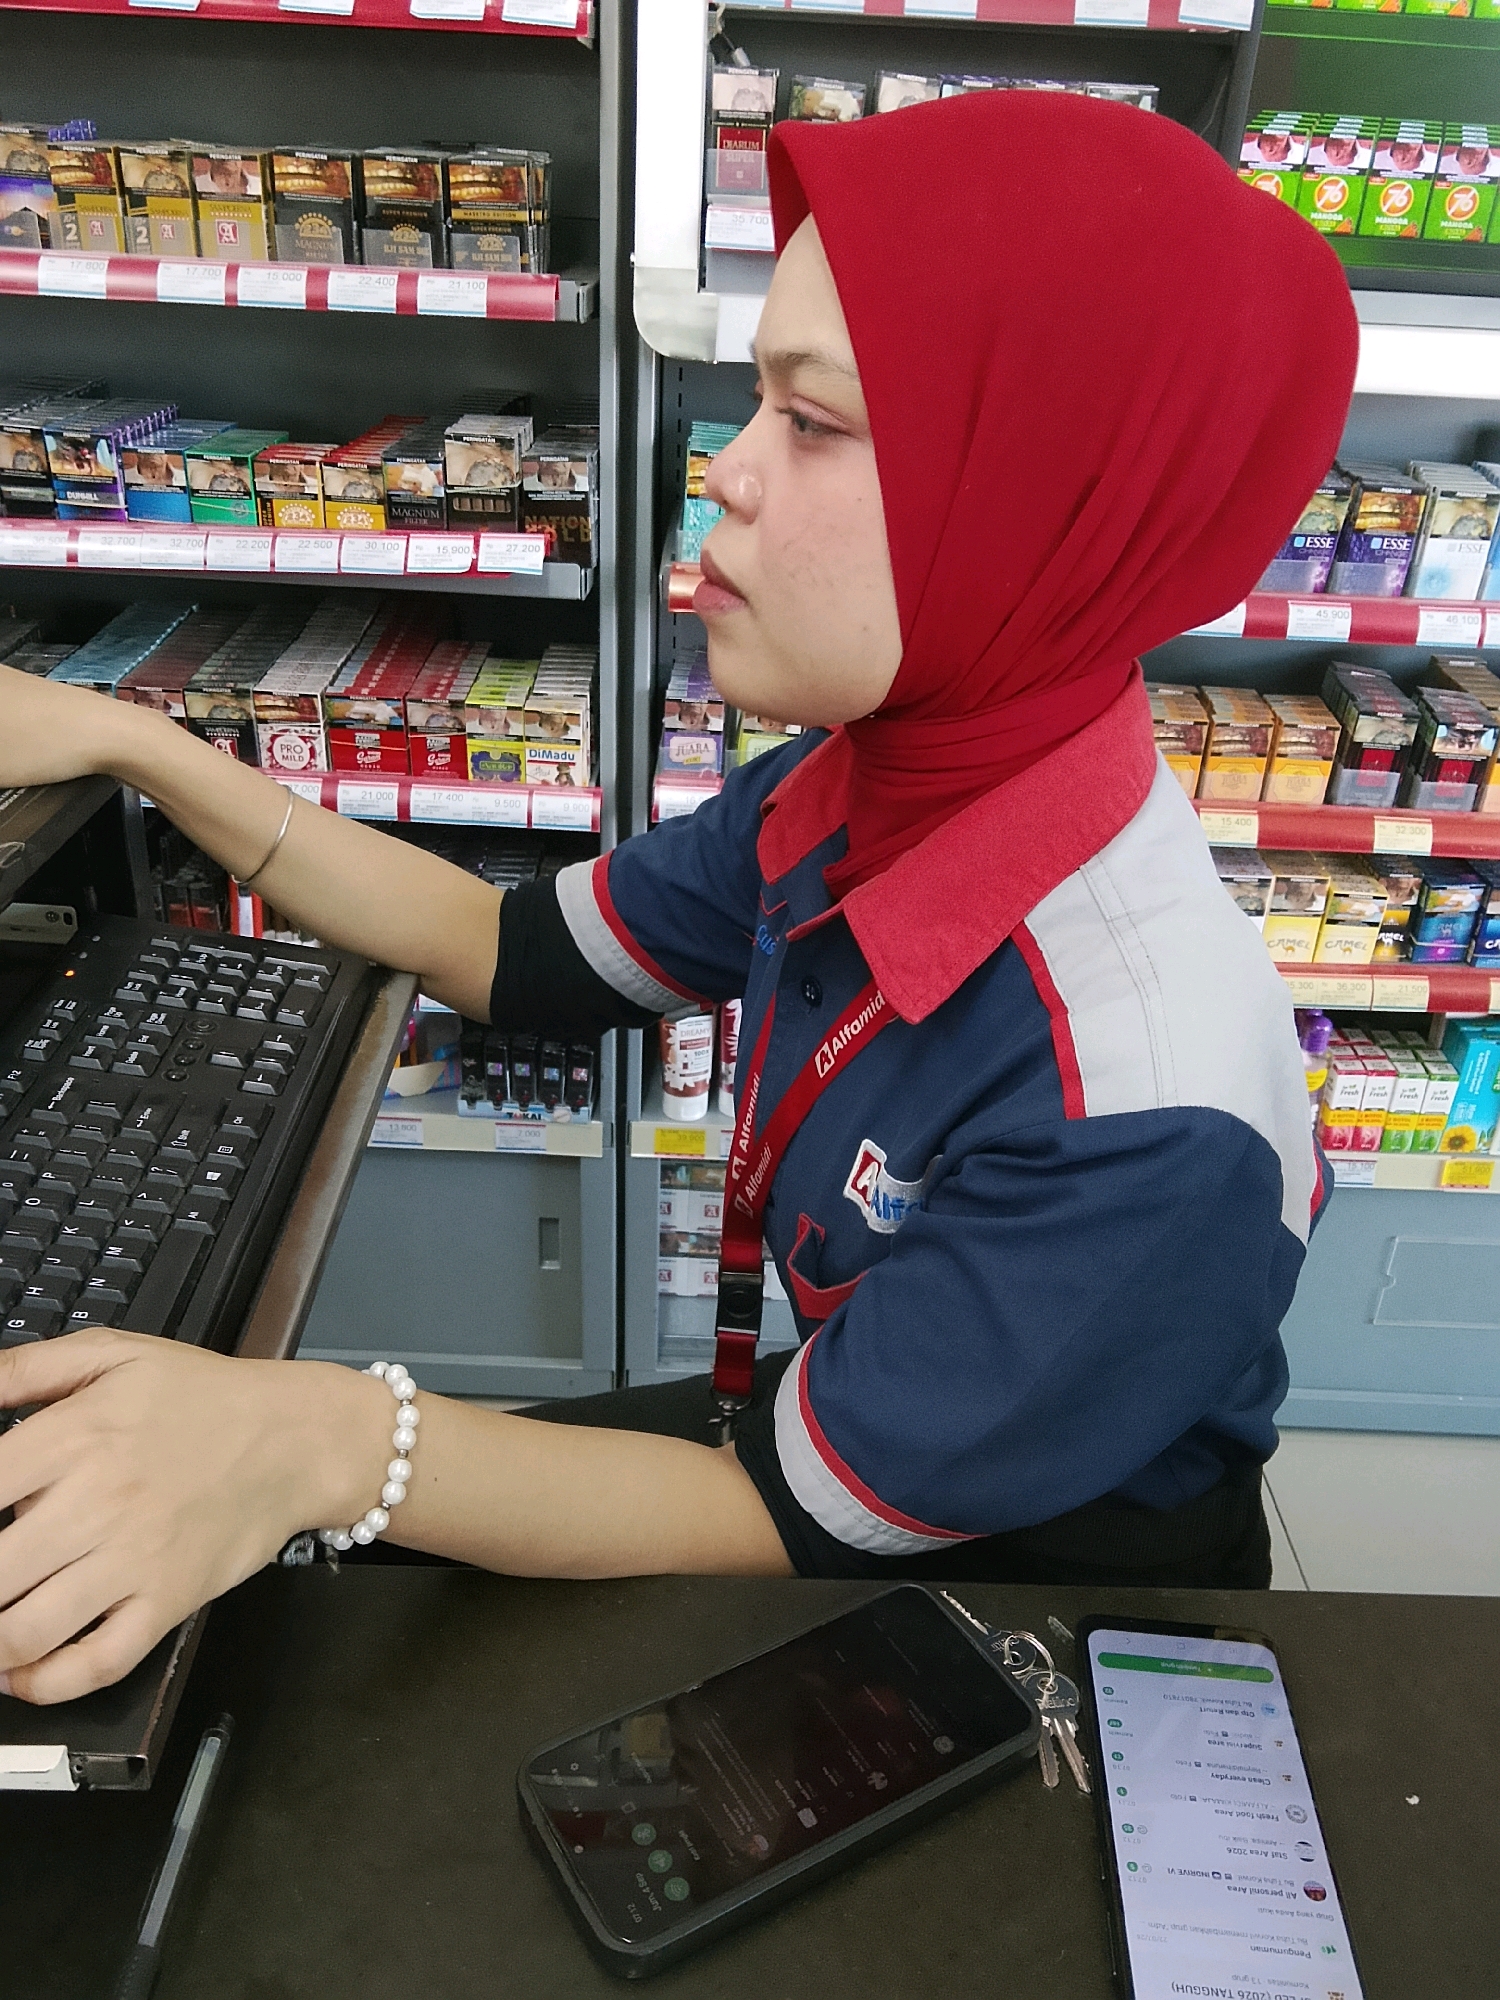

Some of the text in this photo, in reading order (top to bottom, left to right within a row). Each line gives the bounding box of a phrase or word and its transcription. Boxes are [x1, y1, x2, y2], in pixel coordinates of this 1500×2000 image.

[385, 155, 418, 163] PERINGATAN
[1317, 180, 1346, 208] 76
[1383, 184, 1411, 212] 76
[1448, 188, 1476, 216] 76
[391, 508, 440, 519] MAGNUM
[524, 515, 591, 529] NATION
[1305, 537, 1335, 549] ESSE
[1382, 538, 1412, 550] ESSE
[280, 744, 304, 754] PRO
[529, 749, 575, 761] DiMadu
[675, 743, 710, 757] JUARA
[1377, 932, 1405, 941] AMEL
[1266, 938, 1311, 950] CAMEL
[1325, 940, 1368, 951] CAMEL
[832, 990, 886, 1056] Alfamid
[680, 1028, 711, 1037] DREAMY
[7, 1069, 22, 1080] F12
[1400, 1092, 1418, 1100] Fresh
[739, 1072, 760, 1153] Alfamidi
[745, 1142, 772, 1202] Alfamidi
[25, 1197, 41, 1206] O
[61, 1226, 80, 1235] K
[105, 1246, 124, 1256] M
[88, 1278, 106, 1287] N
[25, 1286, 44, 1296] H
[71, 1311, 89, 1319] B
[7, 1319, 25, 1328] G
[1210, 1772, 1271, 1786] Clean everyday
[1214, 1809, 1279, 1822] Fresh food Area
[1226, 1847, 1288, 1860] Staf Area 2026
[1227, 1885, 1297, 1900] All personil Area
[1250, 1946, 1312, 1959] Pengumuman
[1231, 1975, 1250, 1983] grup
[1268, 1979, 1309, 1990] Komunitas
[1171, 1982, 1235, 1999] TANGGUH)
